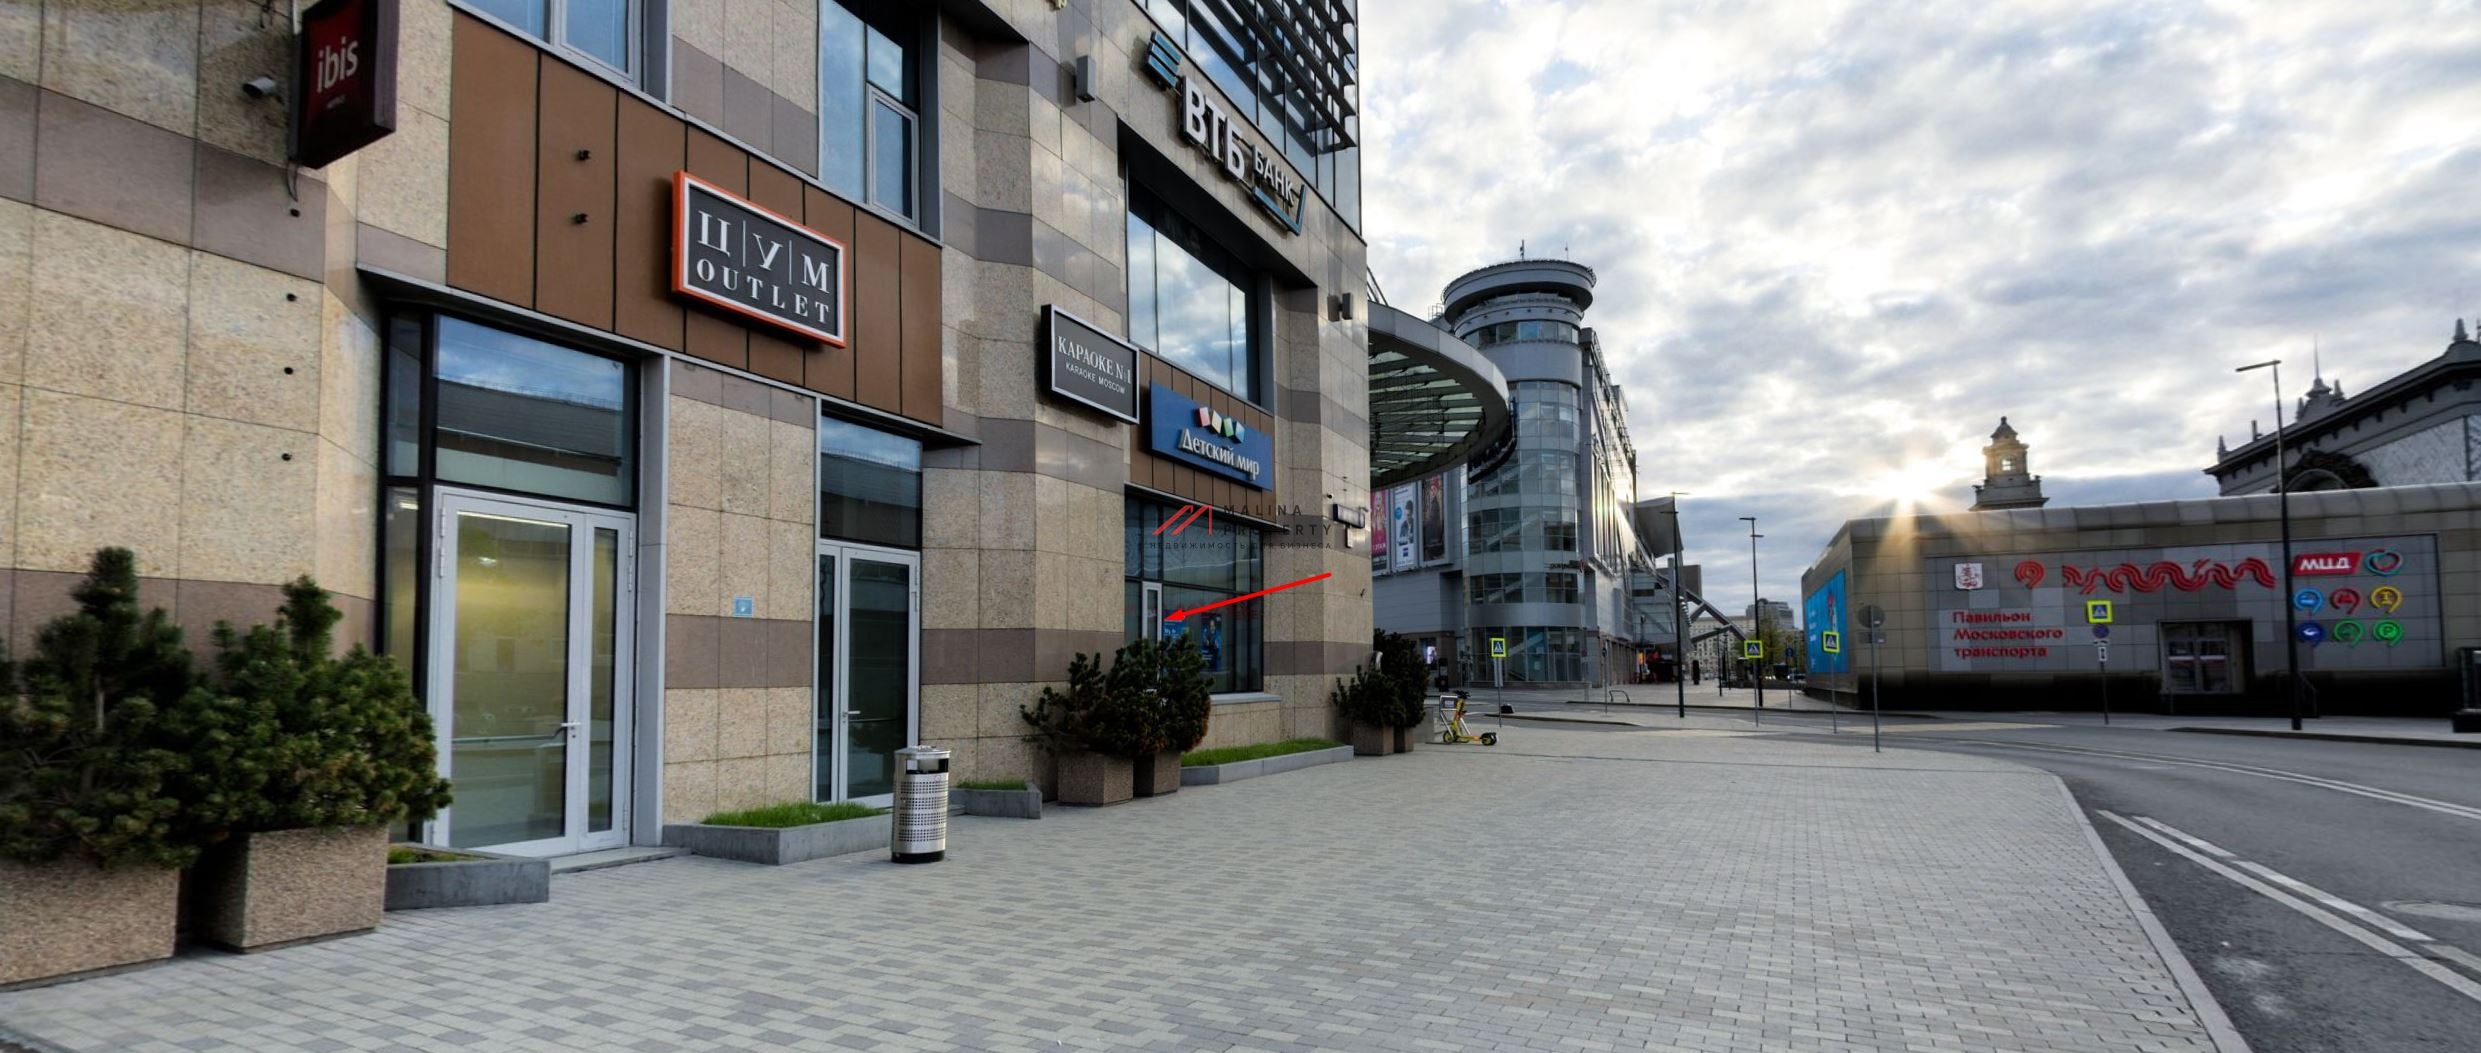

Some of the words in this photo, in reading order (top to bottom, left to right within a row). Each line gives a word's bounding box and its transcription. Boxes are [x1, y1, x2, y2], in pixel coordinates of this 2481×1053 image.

[316, 35, 359, 94] ibis
[1184, 75, 1245, 181] ВТБ
[1254, 145, 1294, 206] БАНК
[696, 258, 829, 324] OUTLET
[1058, 336, 1114, 375] КАРАОКЕ
[1065, 362, 1096, 383] KARAOKE
[1098, 376, 1125, 394] MOSCOW
[1181, 428, 1235, 466] Детский
[1237, 454, 1260, 481] мир
[1953, 611, 2031, 623] Павильон
[1954, 628, 2064, 640] Московского
[1955, 646, 2049, 660] транспорта
